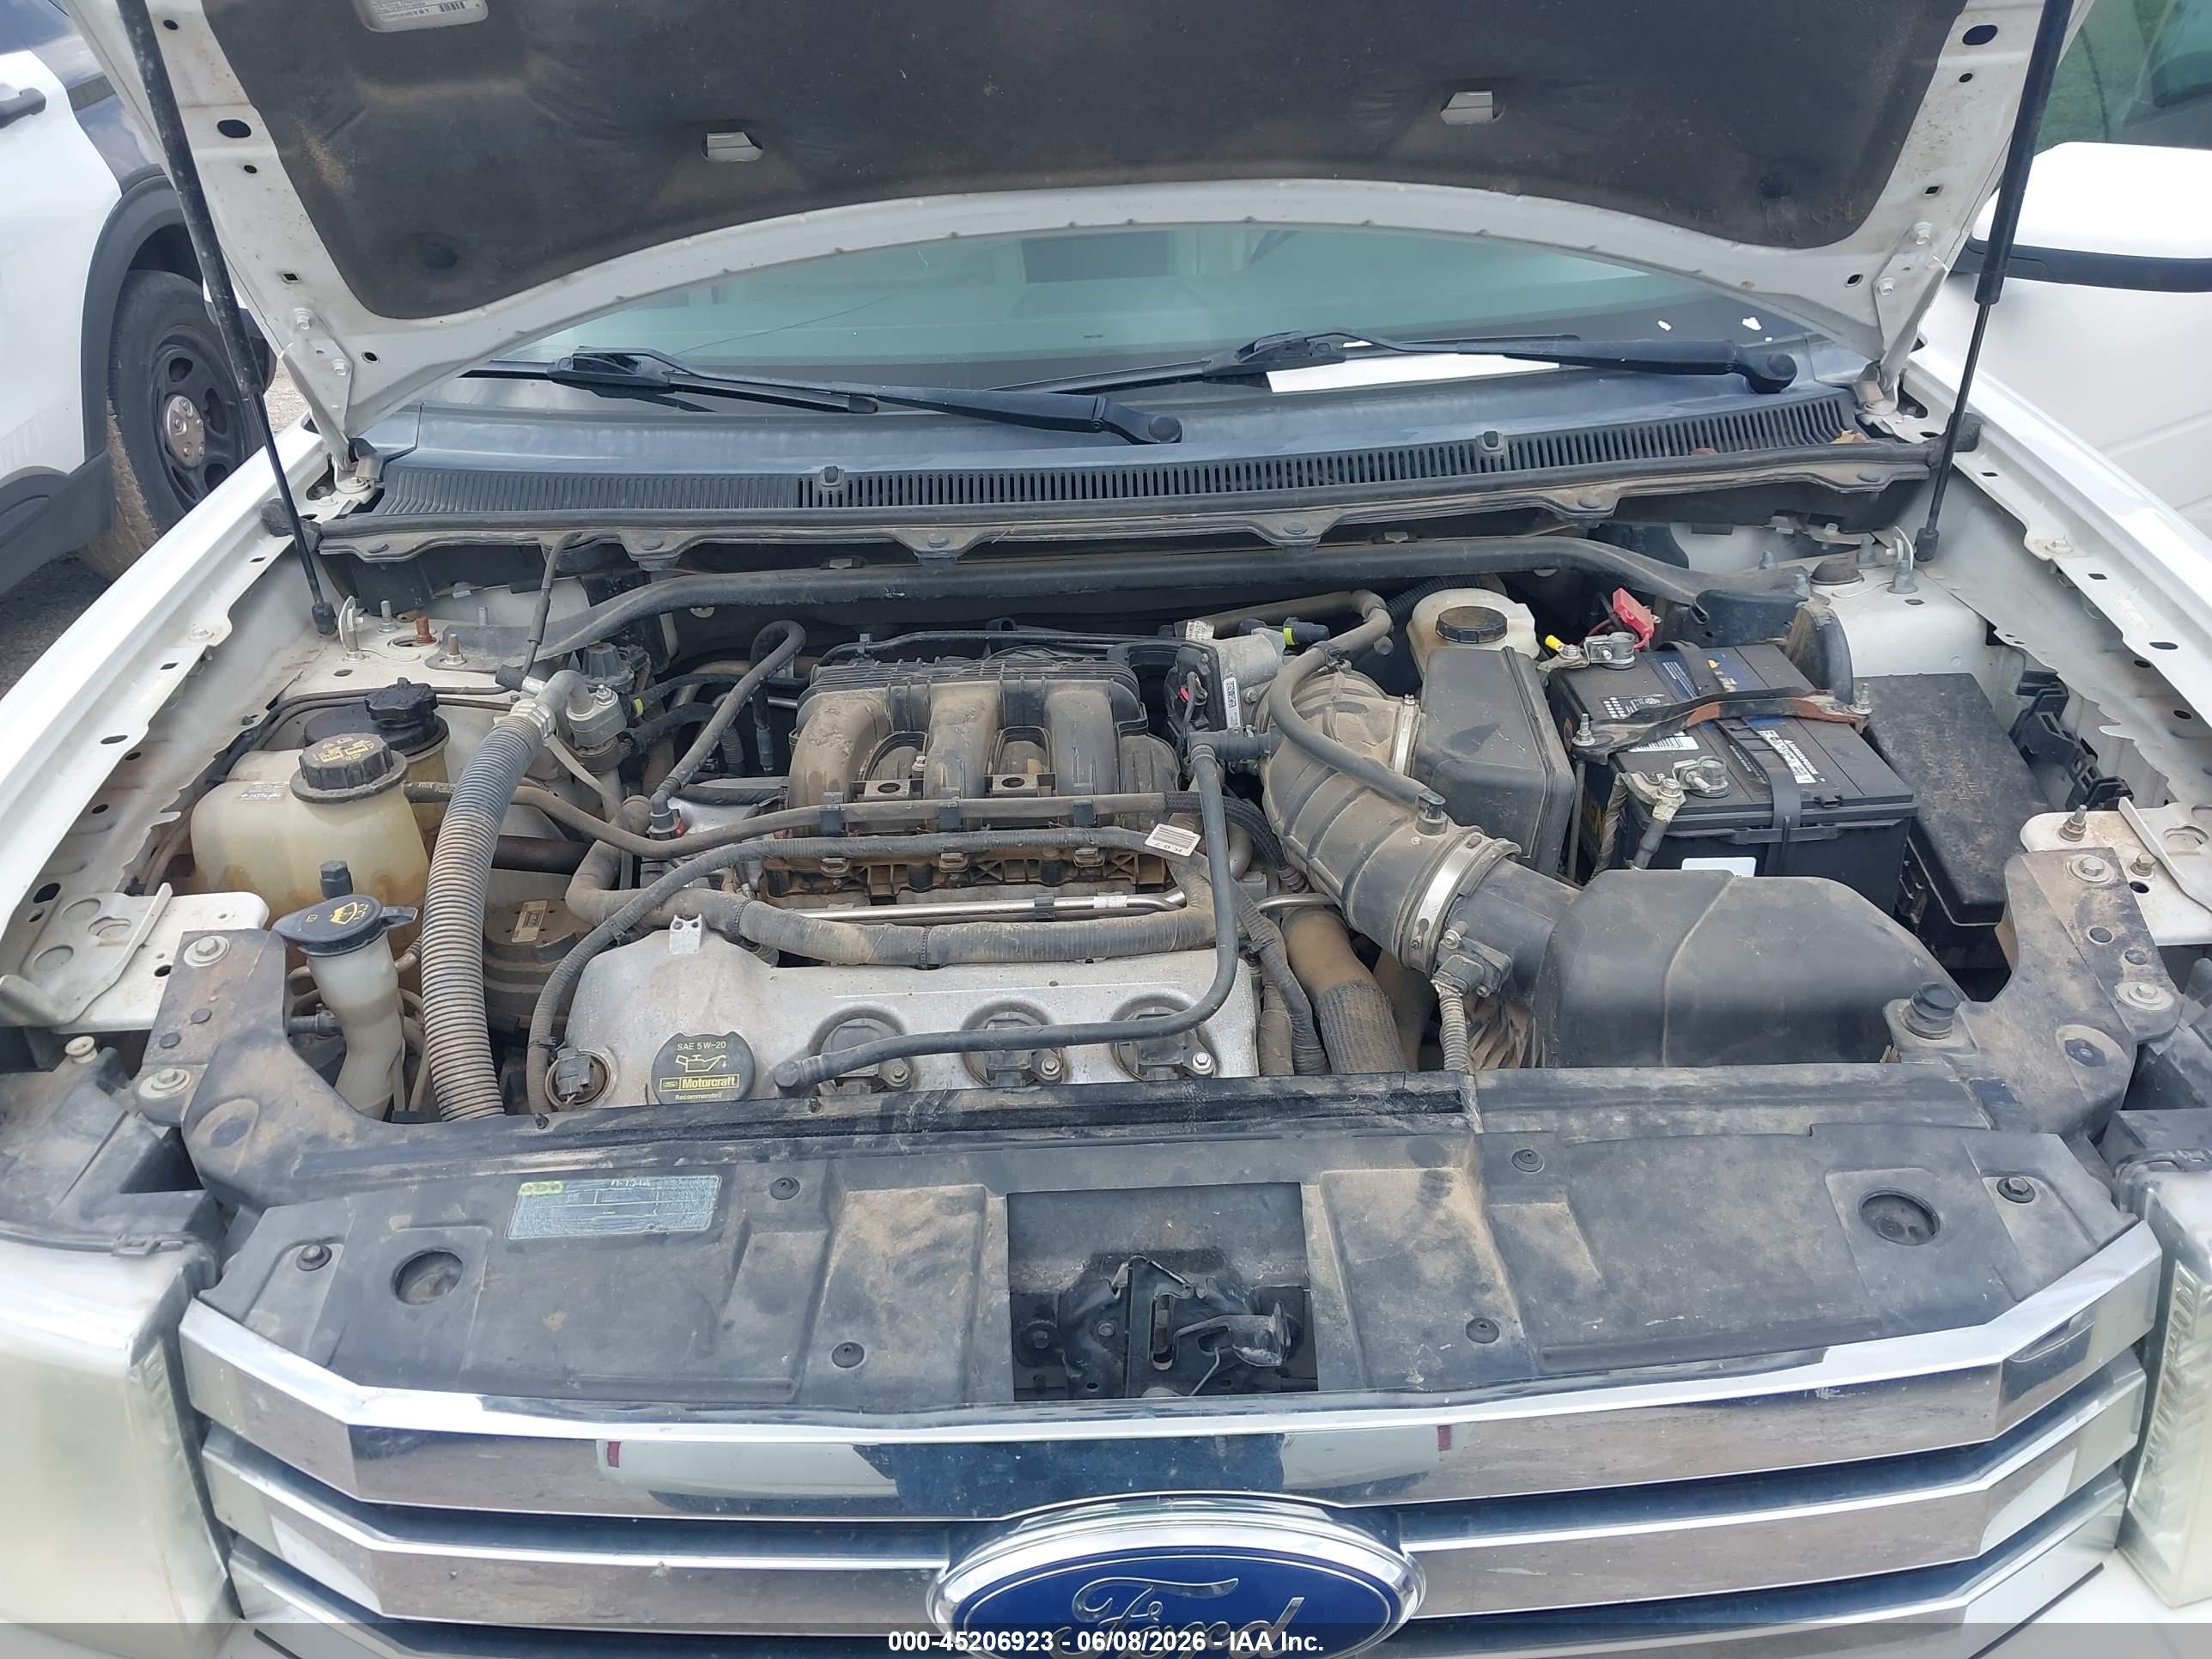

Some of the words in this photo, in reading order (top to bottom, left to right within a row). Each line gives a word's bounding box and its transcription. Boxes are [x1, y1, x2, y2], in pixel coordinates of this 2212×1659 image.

[677, 1042, 695, 1051] SAE
[682, 1076, 737, 1089] Motorcraft
[1052, 1577, 1305, 1659] Ford
